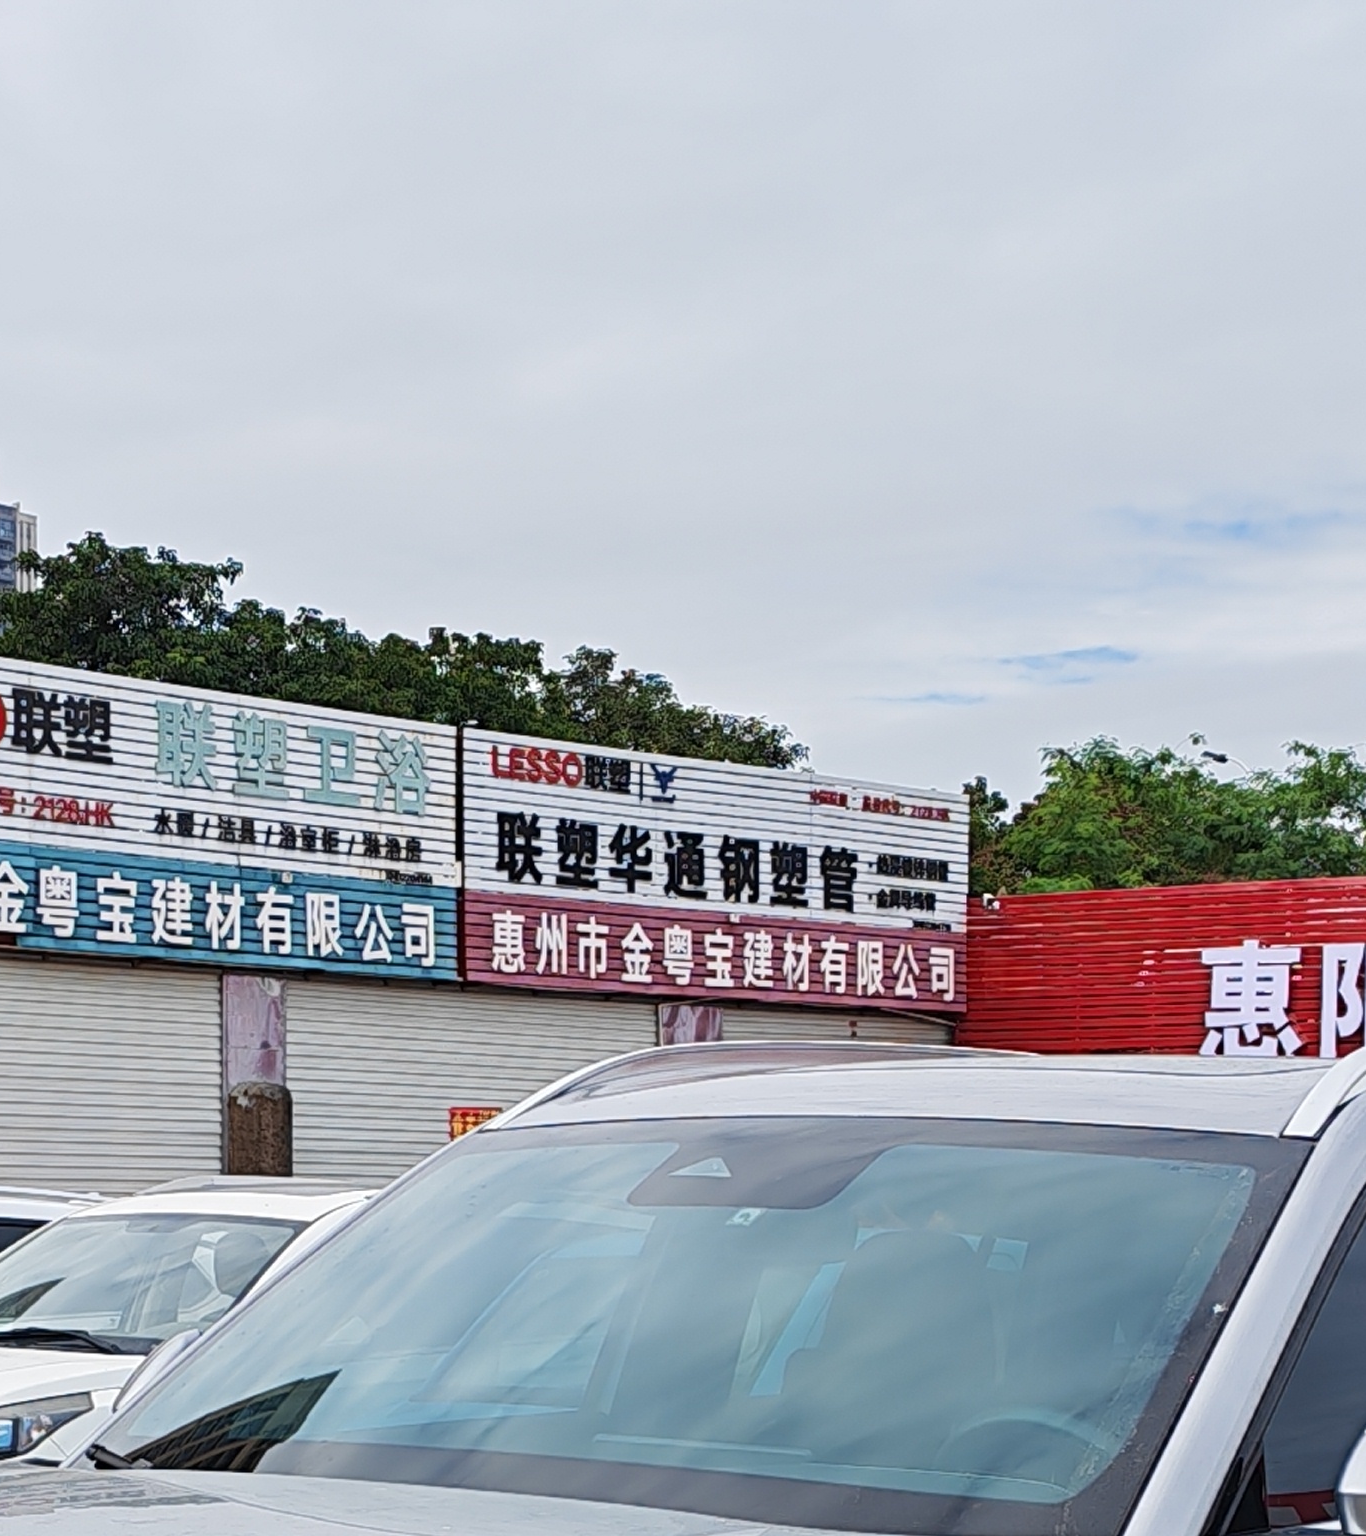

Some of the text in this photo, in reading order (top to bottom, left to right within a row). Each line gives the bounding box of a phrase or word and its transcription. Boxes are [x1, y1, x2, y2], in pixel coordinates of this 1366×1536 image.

[155, 700, 432, 818] 联塑卫浴
[496, 811, 859, 913] 联塑华通钢塑管
[491, 909, 956, 1002] 惠州市金粤宝建材有限公司
